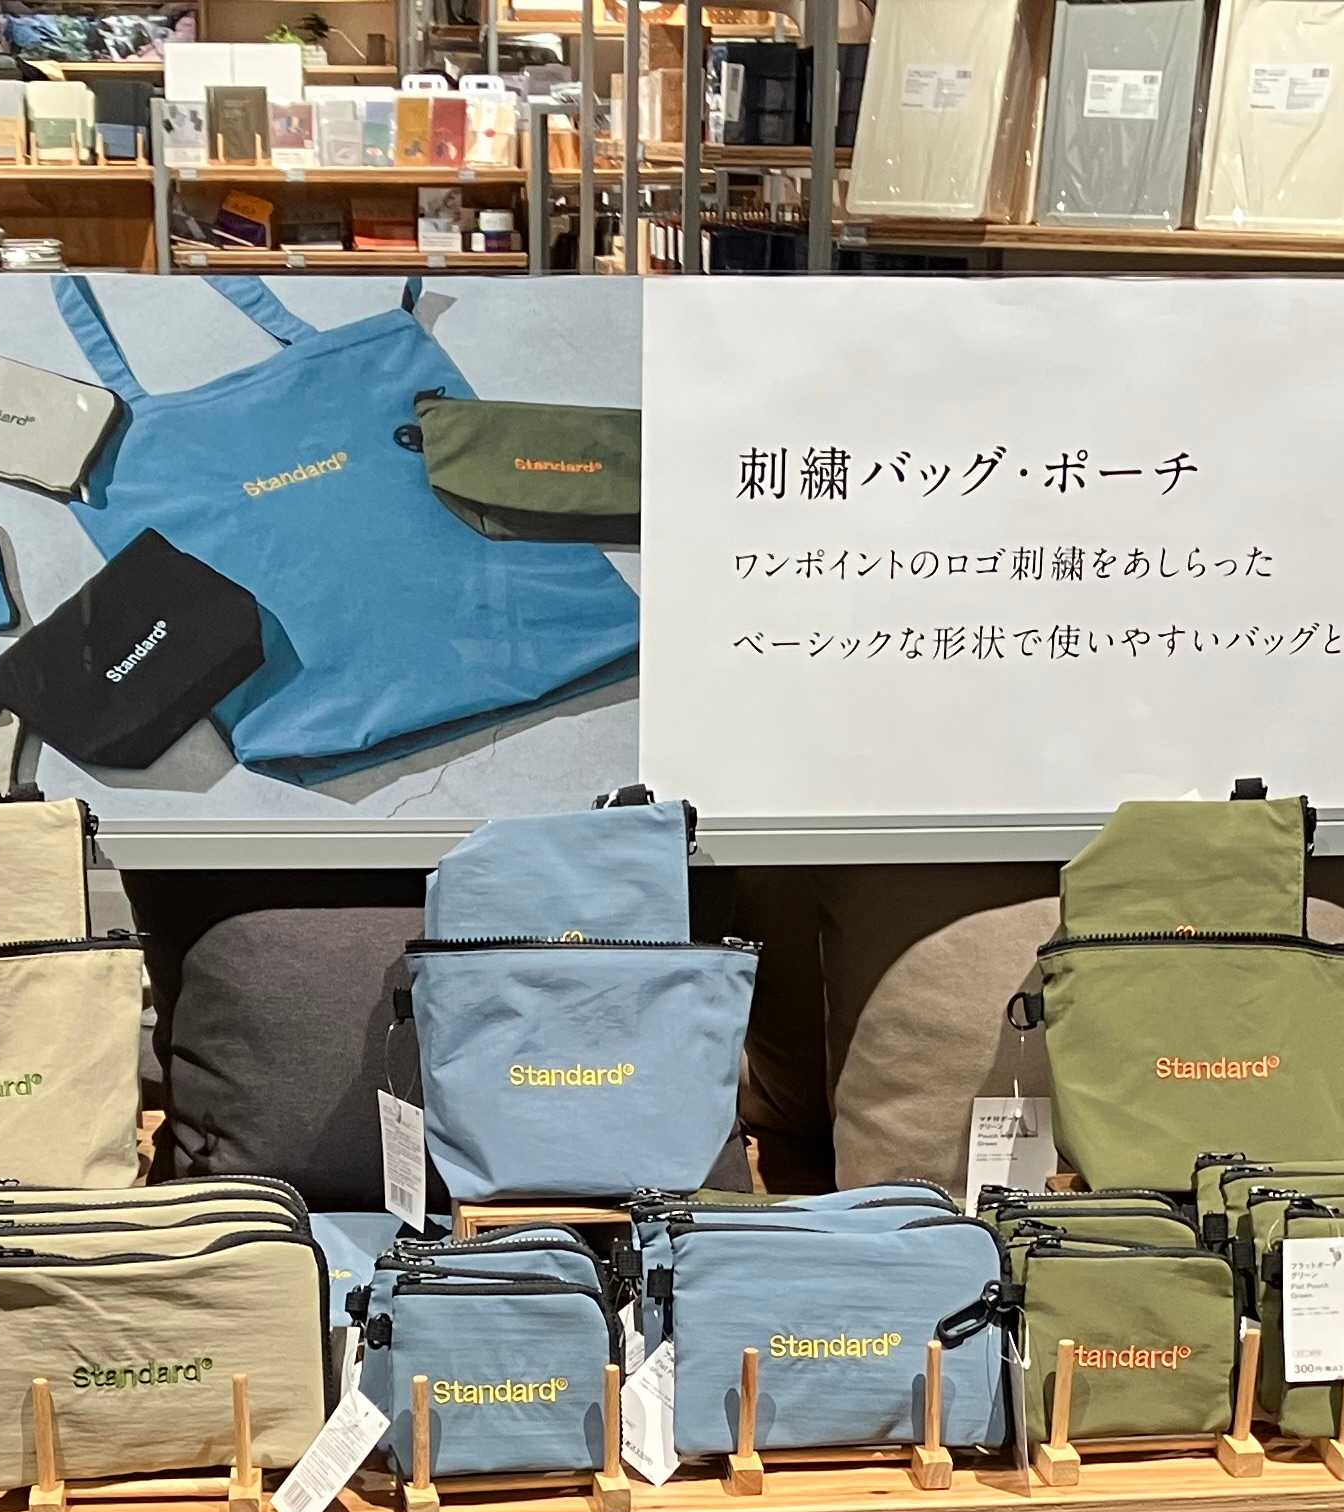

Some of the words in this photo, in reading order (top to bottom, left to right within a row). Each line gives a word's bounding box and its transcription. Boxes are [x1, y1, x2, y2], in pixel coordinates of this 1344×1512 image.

[736, 446, 1199, 500] 刺繍バッグ・ポーチ
[735, 545, 1274, 581] ワンポイントのロゴ刺繍をあしらった
